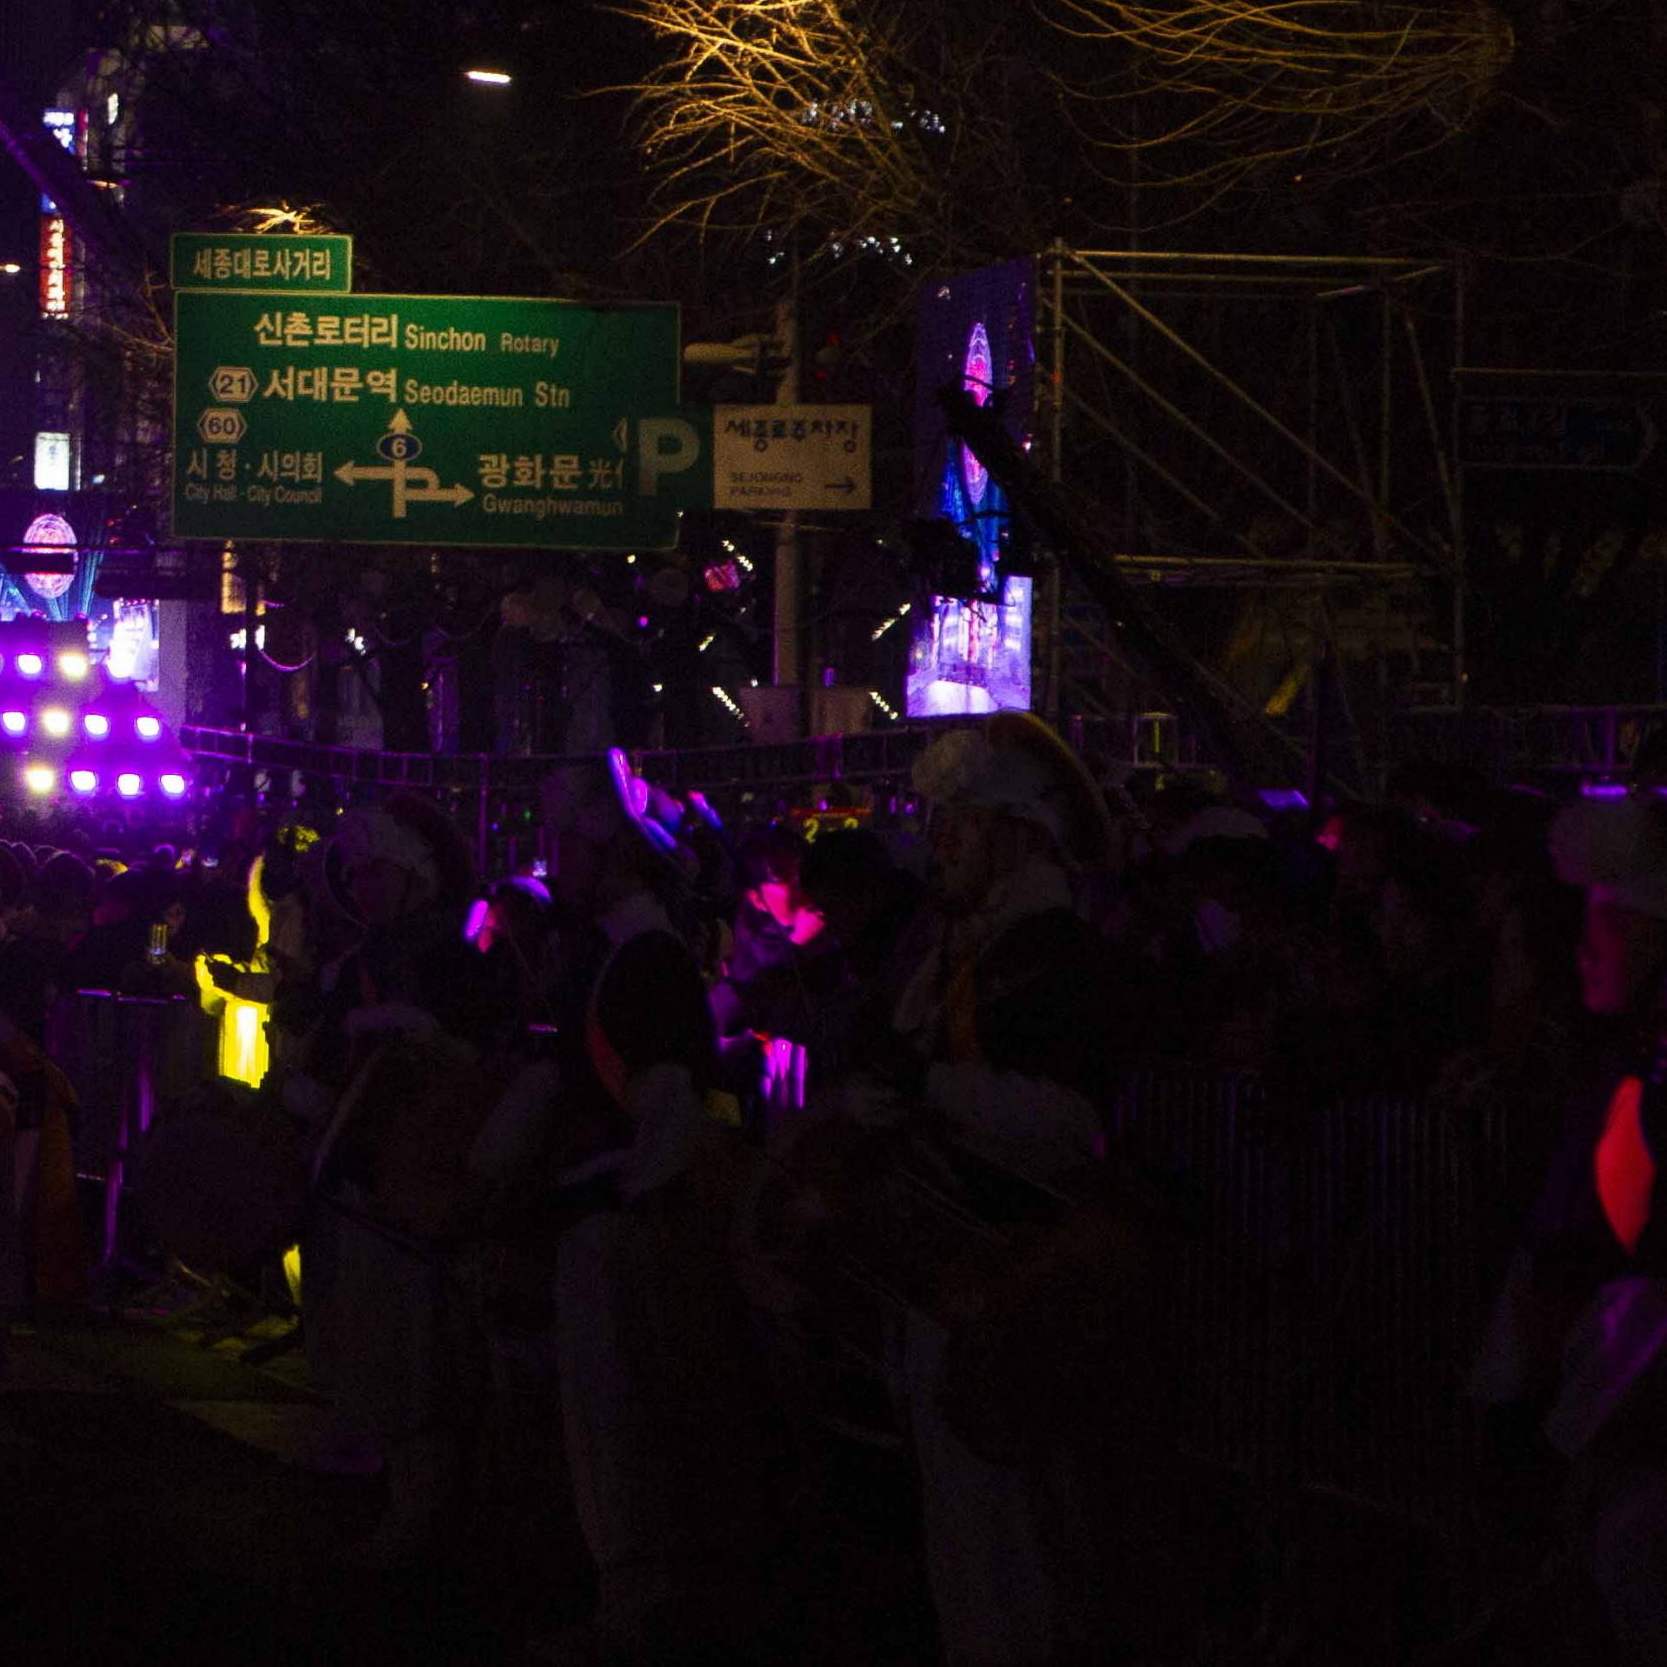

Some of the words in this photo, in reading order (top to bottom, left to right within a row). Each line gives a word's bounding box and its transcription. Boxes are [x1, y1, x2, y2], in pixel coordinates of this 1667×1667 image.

[193, 247, 332, 281] 세종대로사거리
[253, 311, 399, 349] 신촌로터리
[404, 322, 487, 352] Sinchon
[499, 331, 560, 360] Rotary
[218, 373, 249, 395] 21
[261, 365, 398, 403] 서대문역
[404, 377, 524, 408] Seodaemun
[534, 380, 571, 409] Stn
[208, 416, 237, 435] 60
[725, 418, 861, 454] 세종로주차장
[390, 439, 408, 458] 6
[637, 417, 701, 498] P
[477, 452, 583, 491] 광화문
[184, 482, 209, 505] City
[212, 483, 237, 502] Hall
[246, 484, 271, 507] City
[273, 484, 323, 505] Council
[482, 494, 624, 521] Gwanghwamun
